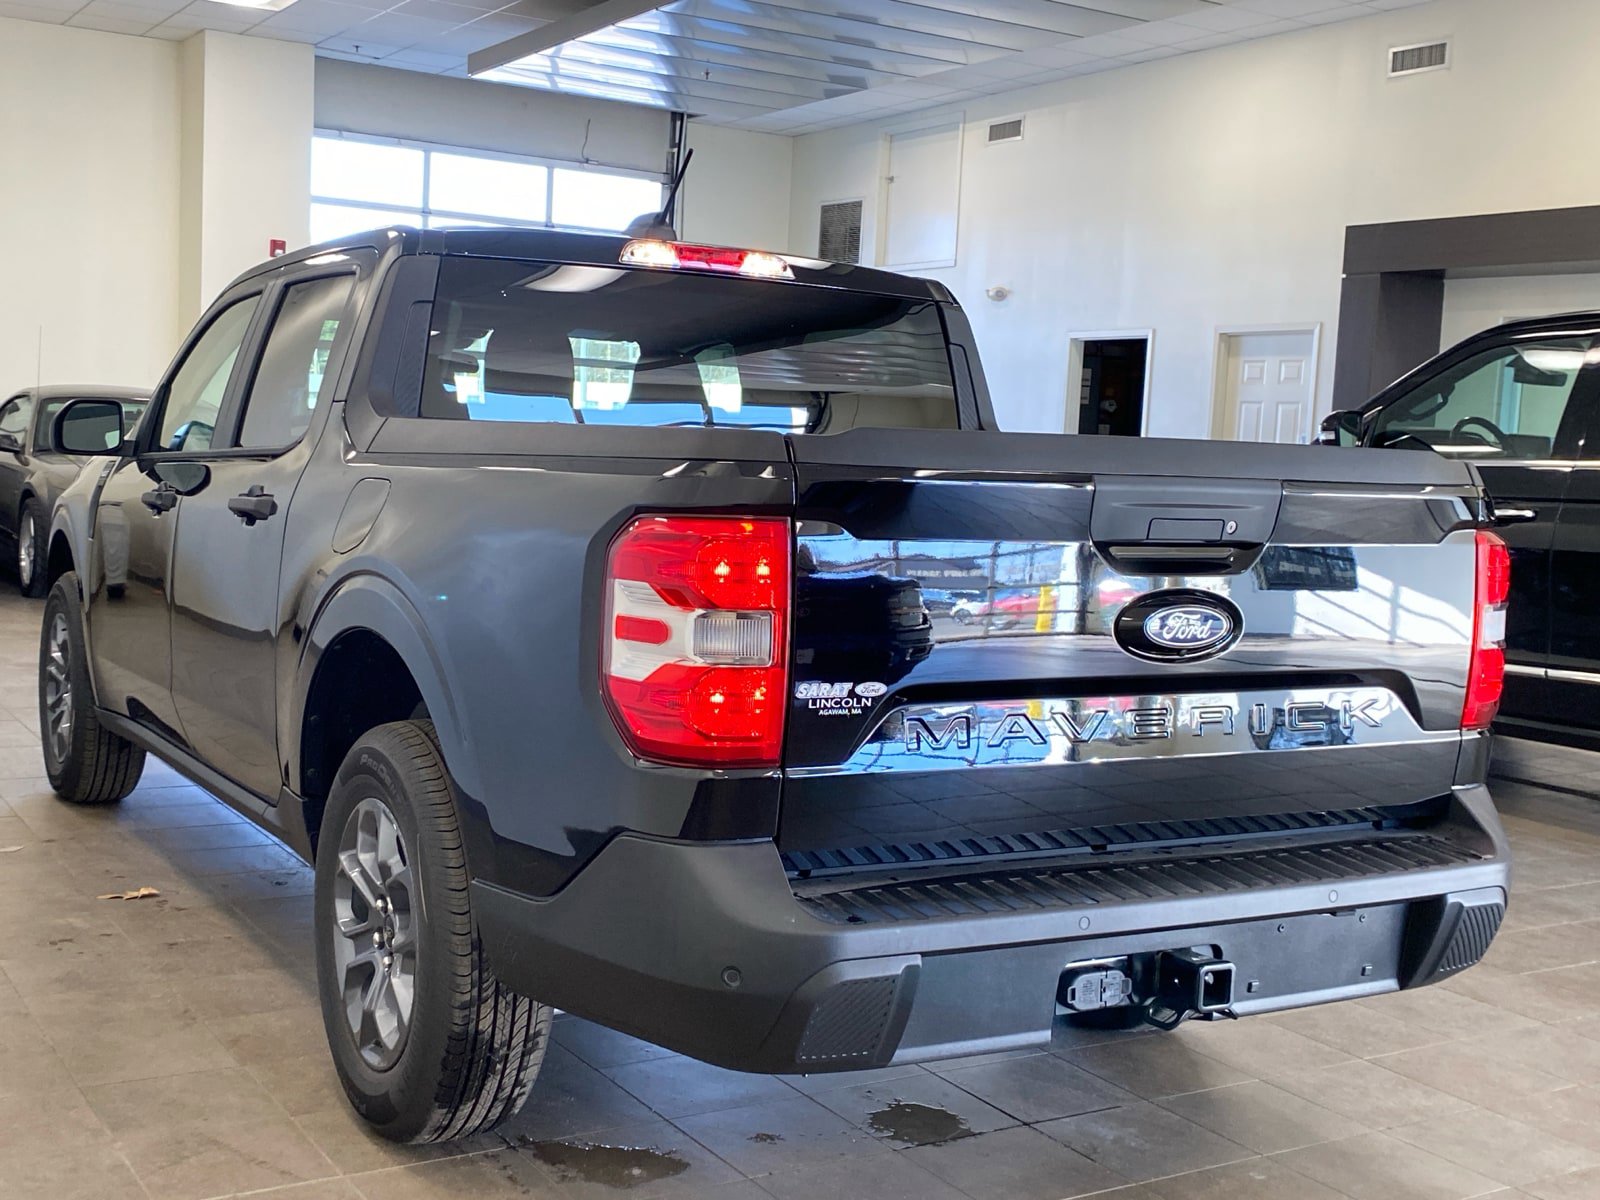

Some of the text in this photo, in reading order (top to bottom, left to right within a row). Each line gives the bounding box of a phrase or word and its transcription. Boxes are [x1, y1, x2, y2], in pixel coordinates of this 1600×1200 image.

[1162, 612, 1214, 640] Ford
[796, 682, 853, 698] SARAT
[808, 698, 872, 709] LINCOLN
[905, 699, 1384, 752] MAVERICK
